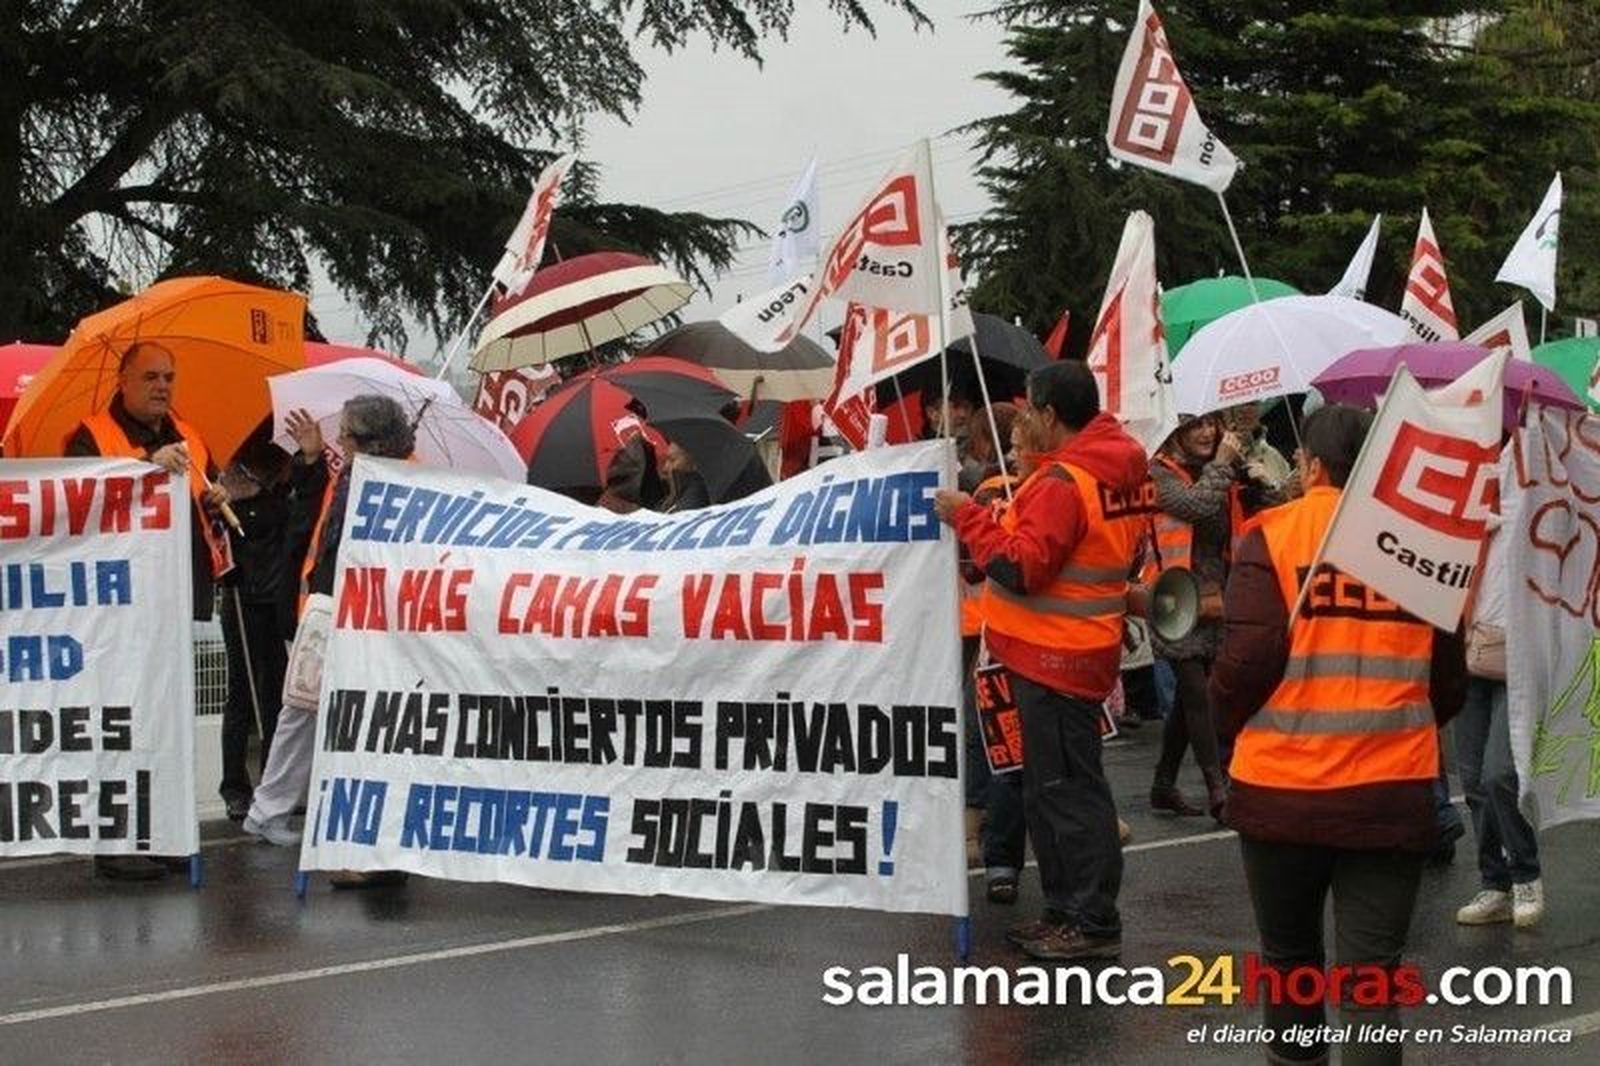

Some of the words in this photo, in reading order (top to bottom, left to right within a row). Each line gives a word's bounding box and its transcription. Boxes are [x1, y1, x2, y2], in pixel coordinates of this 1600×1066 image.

[1223, 369, 1275, 391] CCOO
[0, 559, 132, 609] ILIA
[336, 567, 388, 632] NO
[397, 552, 475, 633] MÁS
[498, 572, 660, 639] CAMAS
[681, 557, 885, 643] VACÍAS
[0, 634, 83, 683] AD
[323, 689, 366, 752] NO
[364, 678, 450, 756] MÁS
[400, 782, 611, 862] RECORTES
